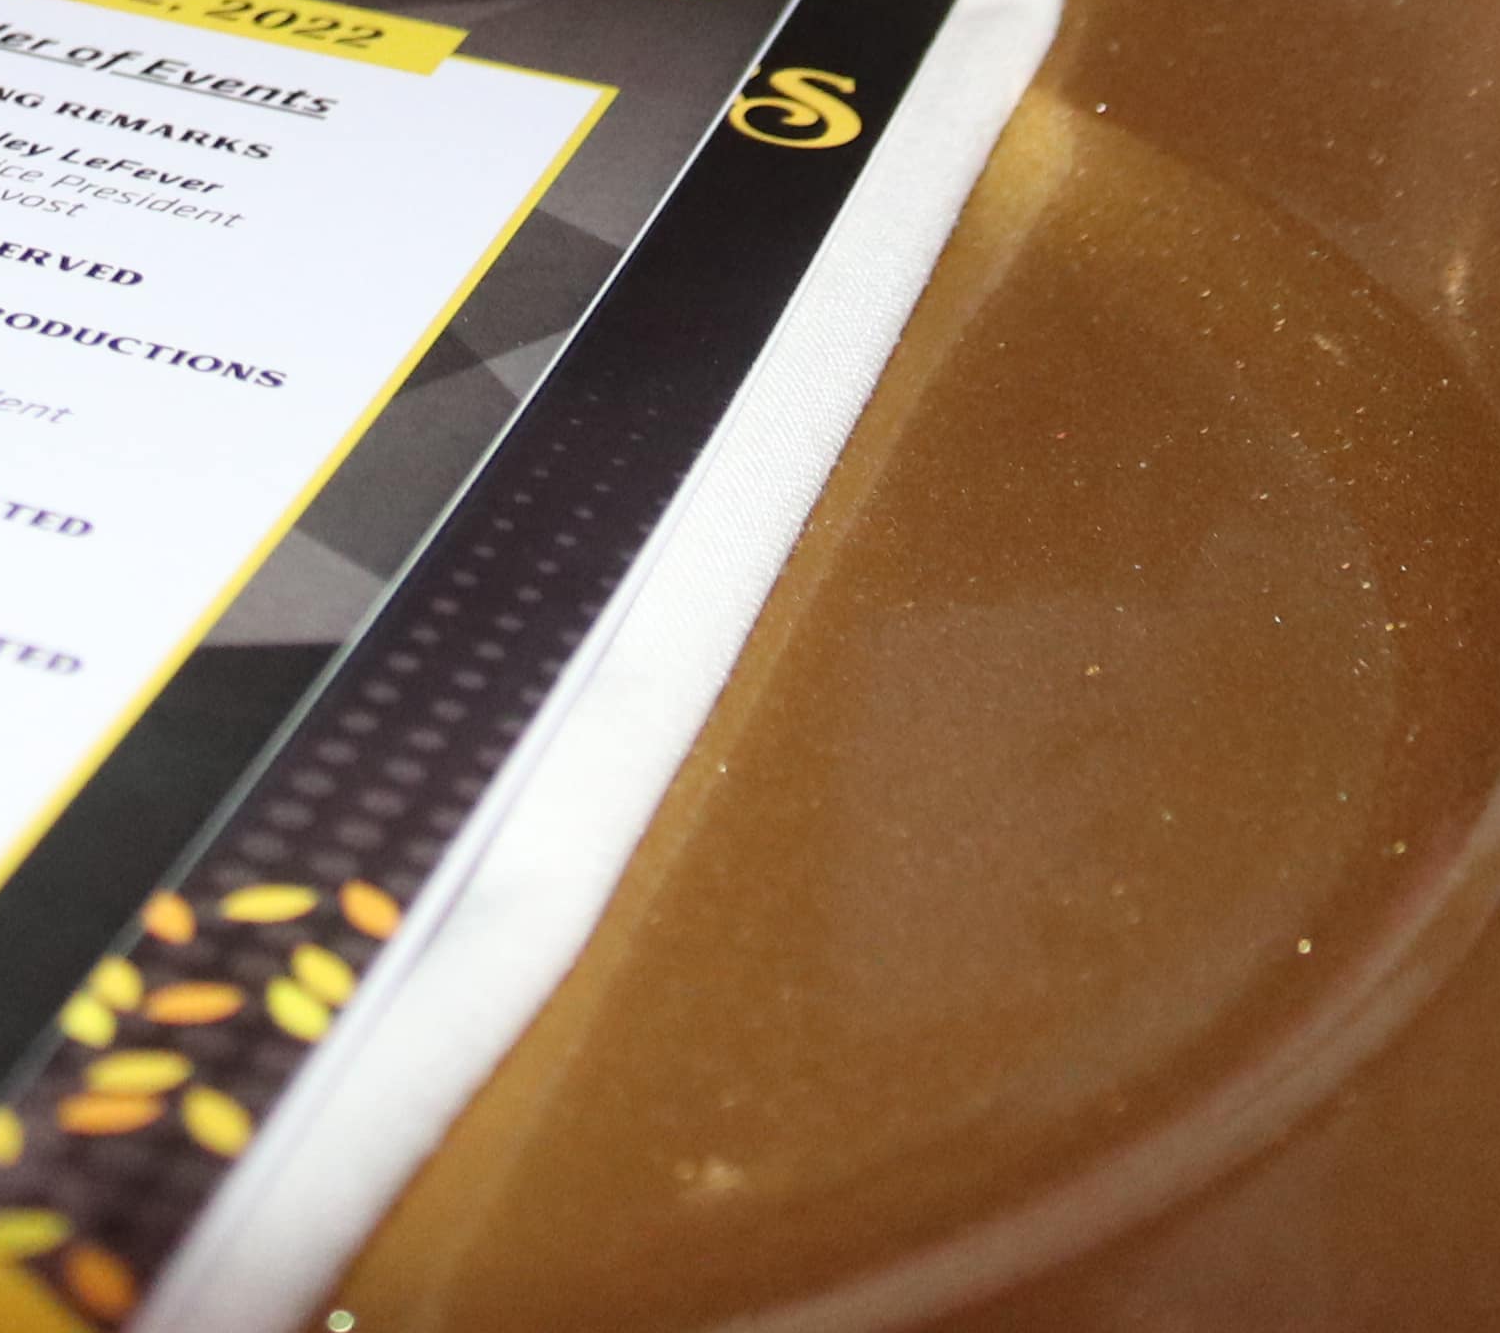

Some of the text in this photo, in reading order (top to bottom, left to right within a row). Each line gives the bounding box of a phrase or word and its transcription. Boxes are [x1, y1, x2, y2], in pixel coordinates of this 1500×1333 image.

[67, 47, 142, 71] of
[141, 59, 338, 116] Events
[56, 101, 273, 159] REMARKS
[59, 148, 224, 194] LeFever
[51, 174, 245, 228] President
